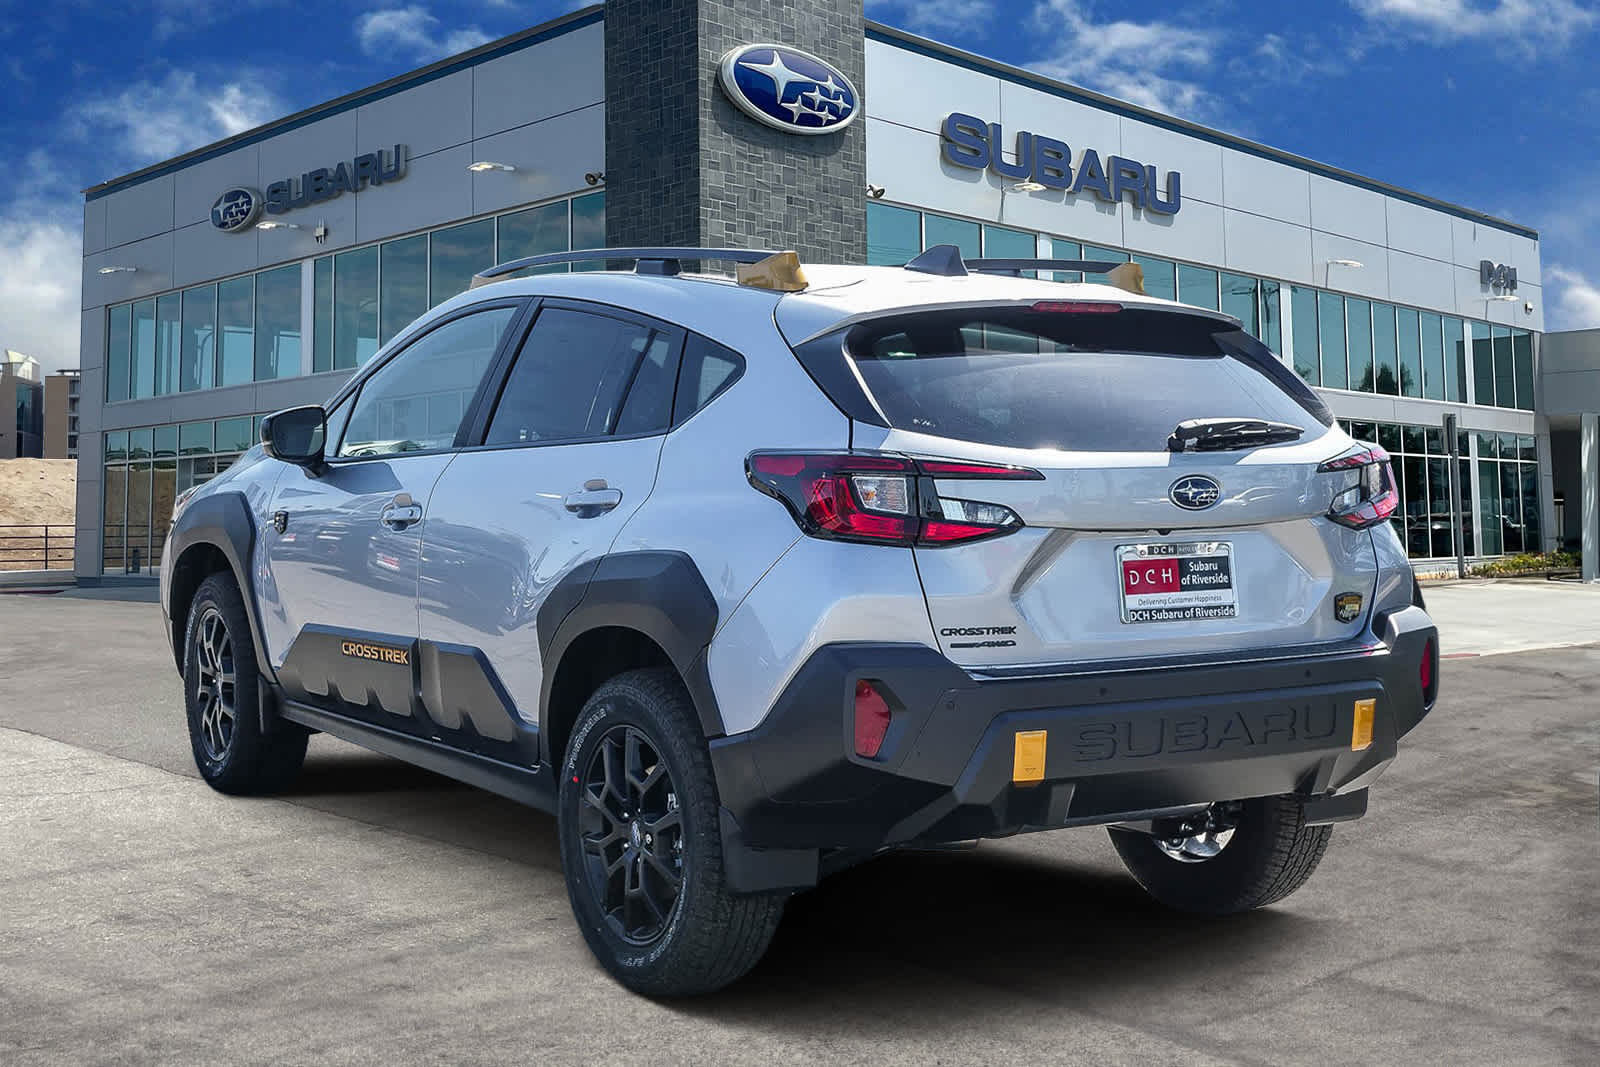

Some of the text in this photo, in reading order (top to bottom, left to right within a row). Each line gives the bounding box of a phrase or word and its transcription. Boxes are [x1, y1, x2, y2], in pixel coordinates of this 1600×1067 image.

[941, 112, 1181, 215] SUBARU
[266, 144, 405, 214] SUBARU
[1188, 561, 1218, 572] Subaru
[1181, 572, 1229, 585] of Riverside
[1130, 606, 1234, 621] DCH Subaru of Riverside
[940, 626, 1017, 637] CROSSTREK
[342, 641, 409, 665] CROSSTREK
[1073, 703, 1338, 763] SUBARU
